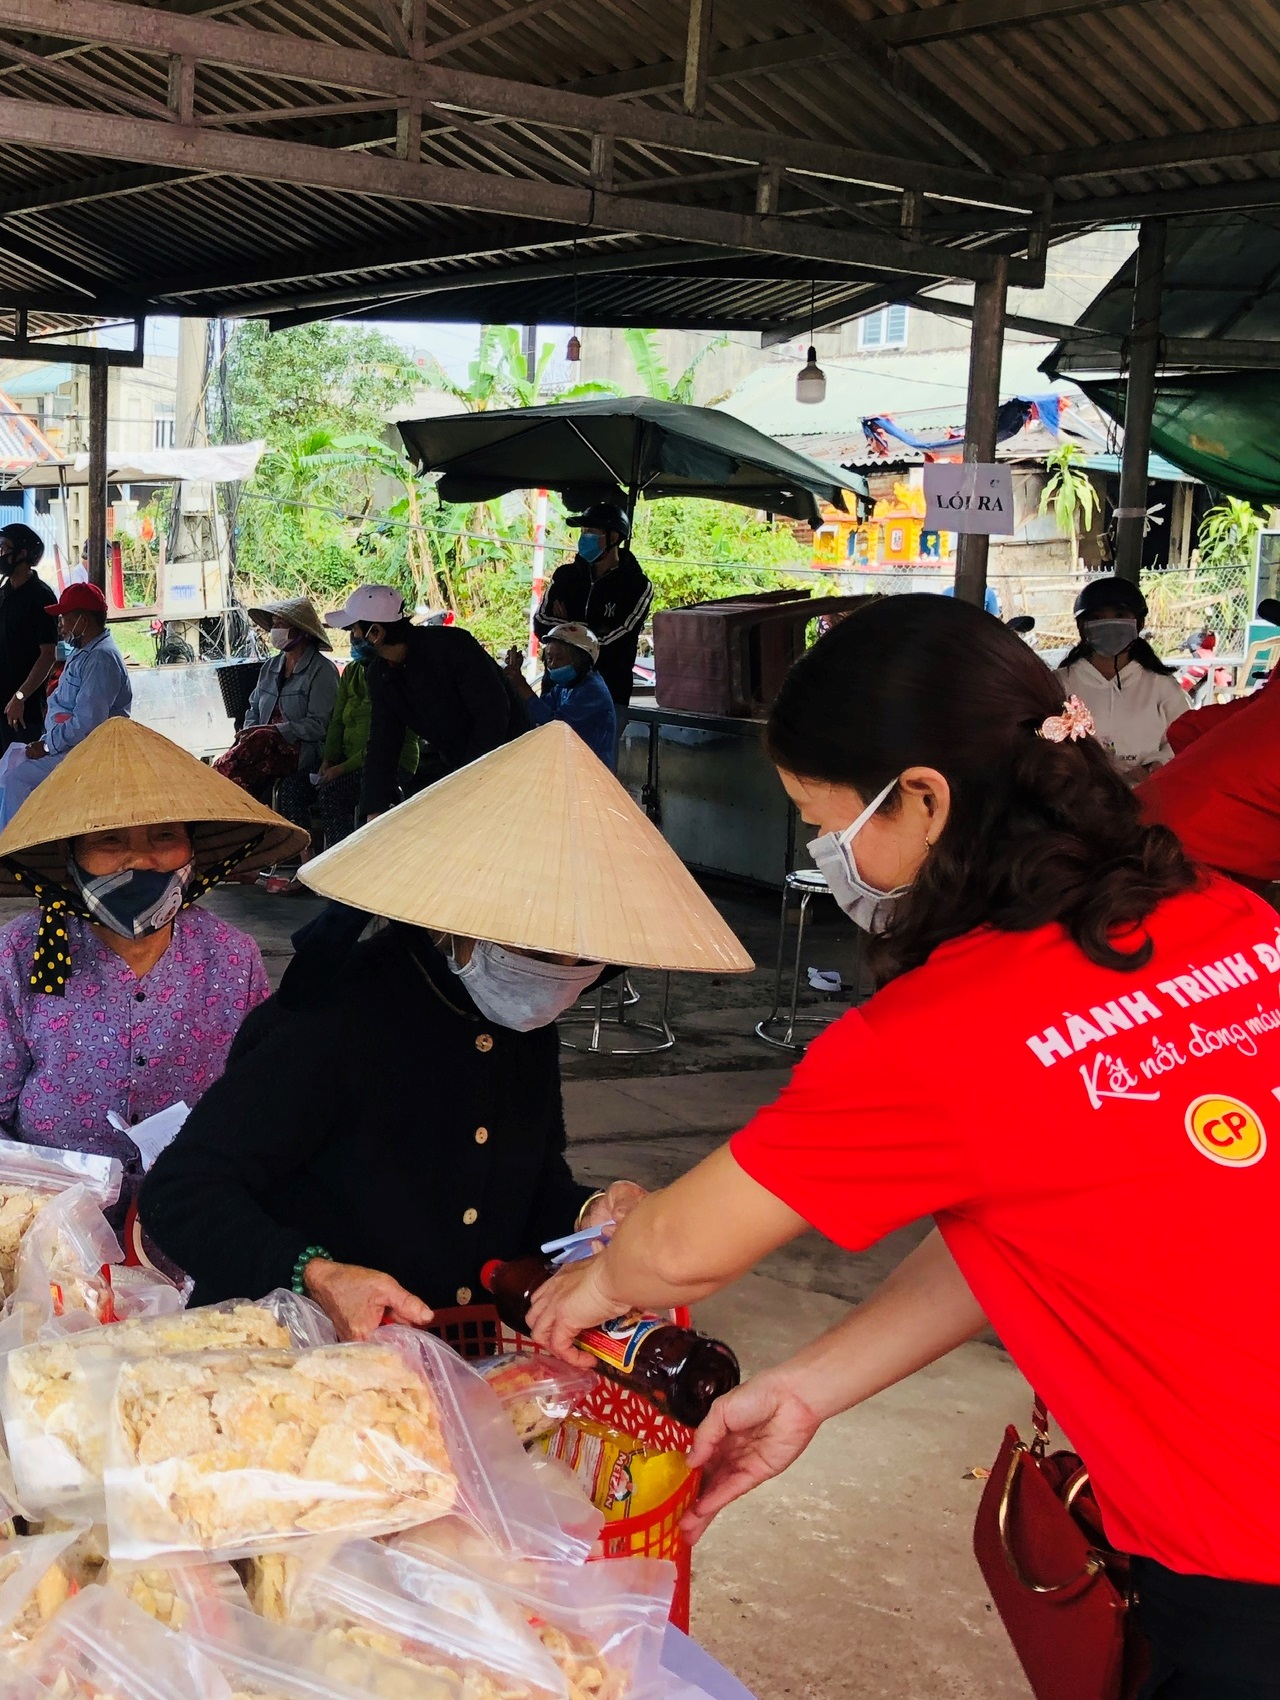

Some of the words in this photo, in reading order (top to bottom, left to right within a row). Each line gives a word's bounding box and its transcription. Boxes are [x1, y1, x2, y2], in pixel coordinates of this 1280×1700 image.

[977, 495, 1004, 512] RA
[1025, 990, 1163, 1068] HÀNH
[1155, 952, 1259, 1009] TRÌNH
[1251, 926, 1280, 974] Đ
[1079, 1051, 1161, 1110] Kết
[1139, 1035, 1187, 1079] nối
[1202, 1111, 1248, 1148] CP
